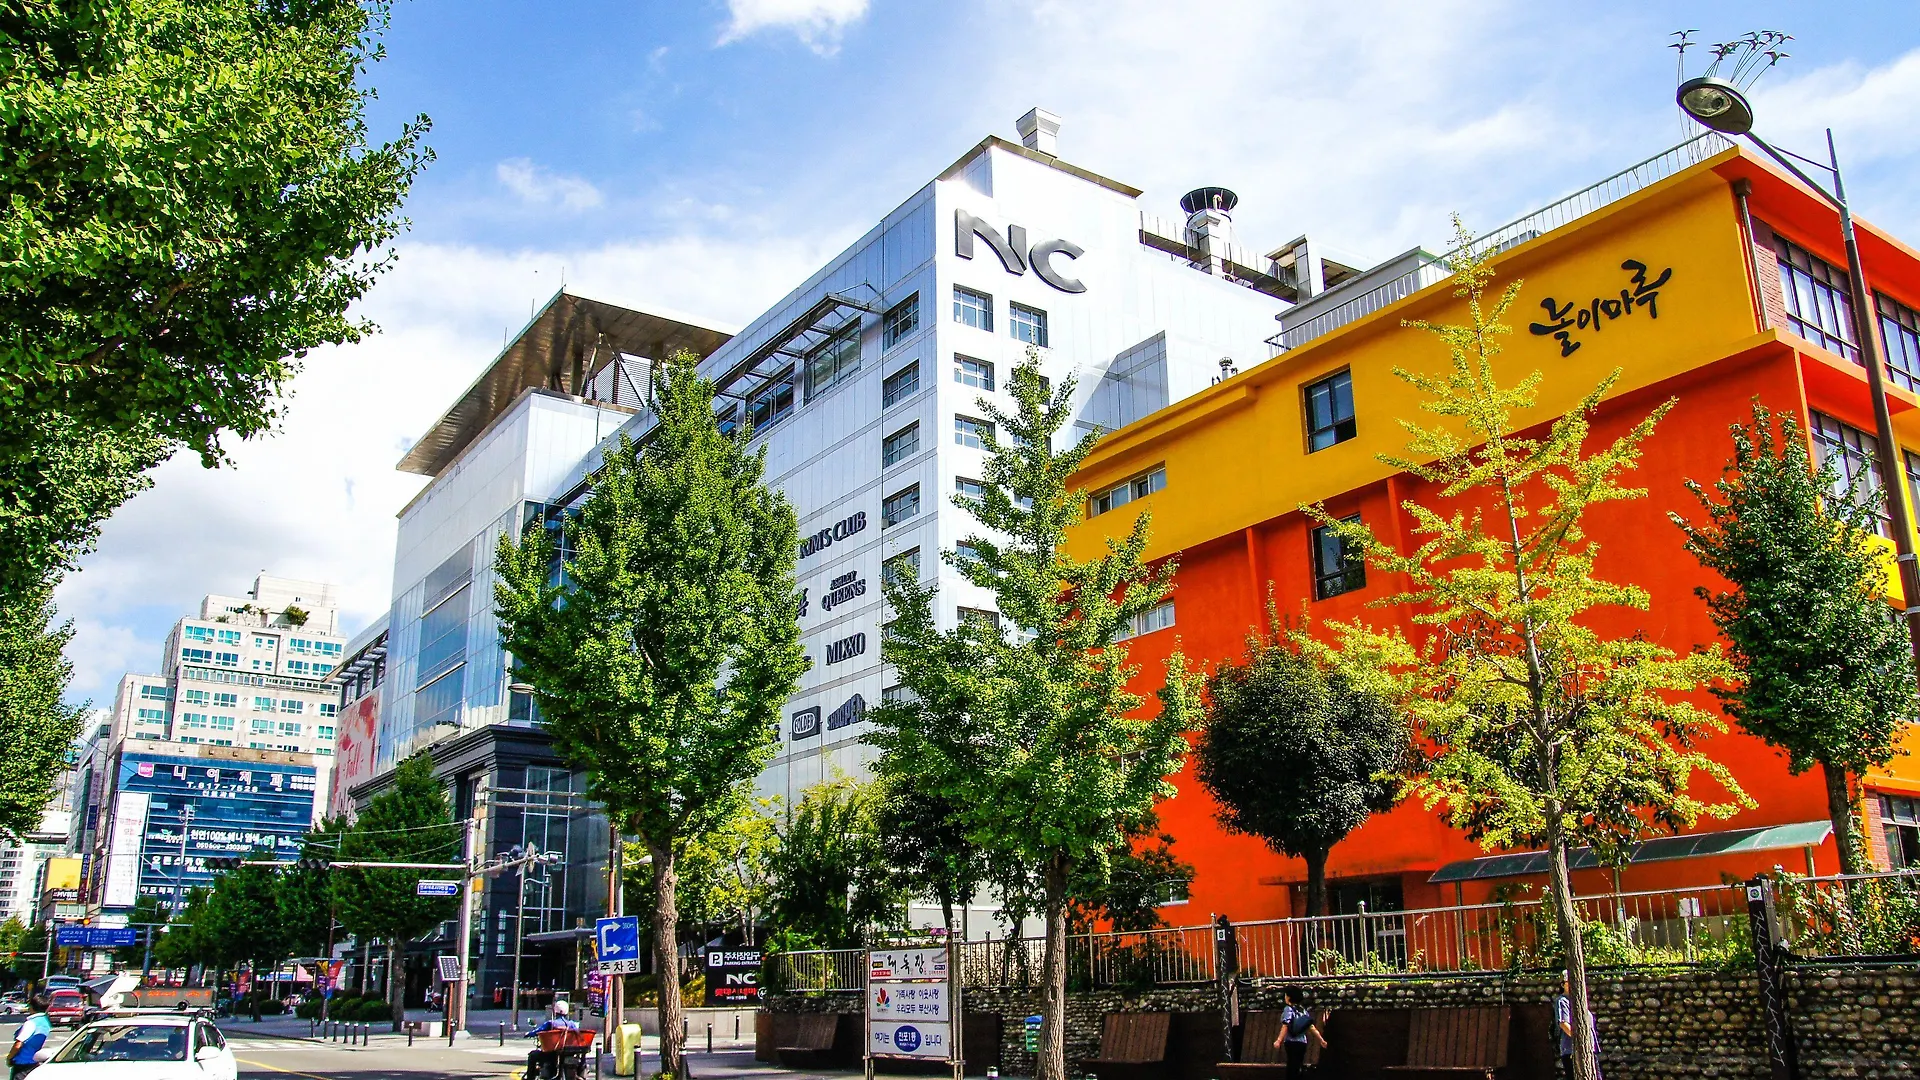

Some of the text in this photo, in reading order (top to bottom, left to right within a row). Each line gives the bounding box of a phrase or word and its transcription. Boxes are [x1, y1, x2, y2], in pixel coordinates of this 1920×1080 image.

[954, 208, 1087, 293] NC
[1529, 259, 1672, 357] 놀이마루
[832, 511, 867, 543] CLUB
[825, 632, 866, 666] MIXXO
[794, 714, 813, 733] FOLDER
[724, 951, 761, 961] 주차장입구
[600, 960, 638, 972] 주차장
[726, 972, 757, 985] NC
[896, 988, 940, 1000] 가족사랑 이웃사랑
[896, 1004, 916, 1014] 우리모두
[919, 1004, 940, 1016] 부산사랑
[875, 1032, 942, 1046] 여기는 전포1동 입니다
